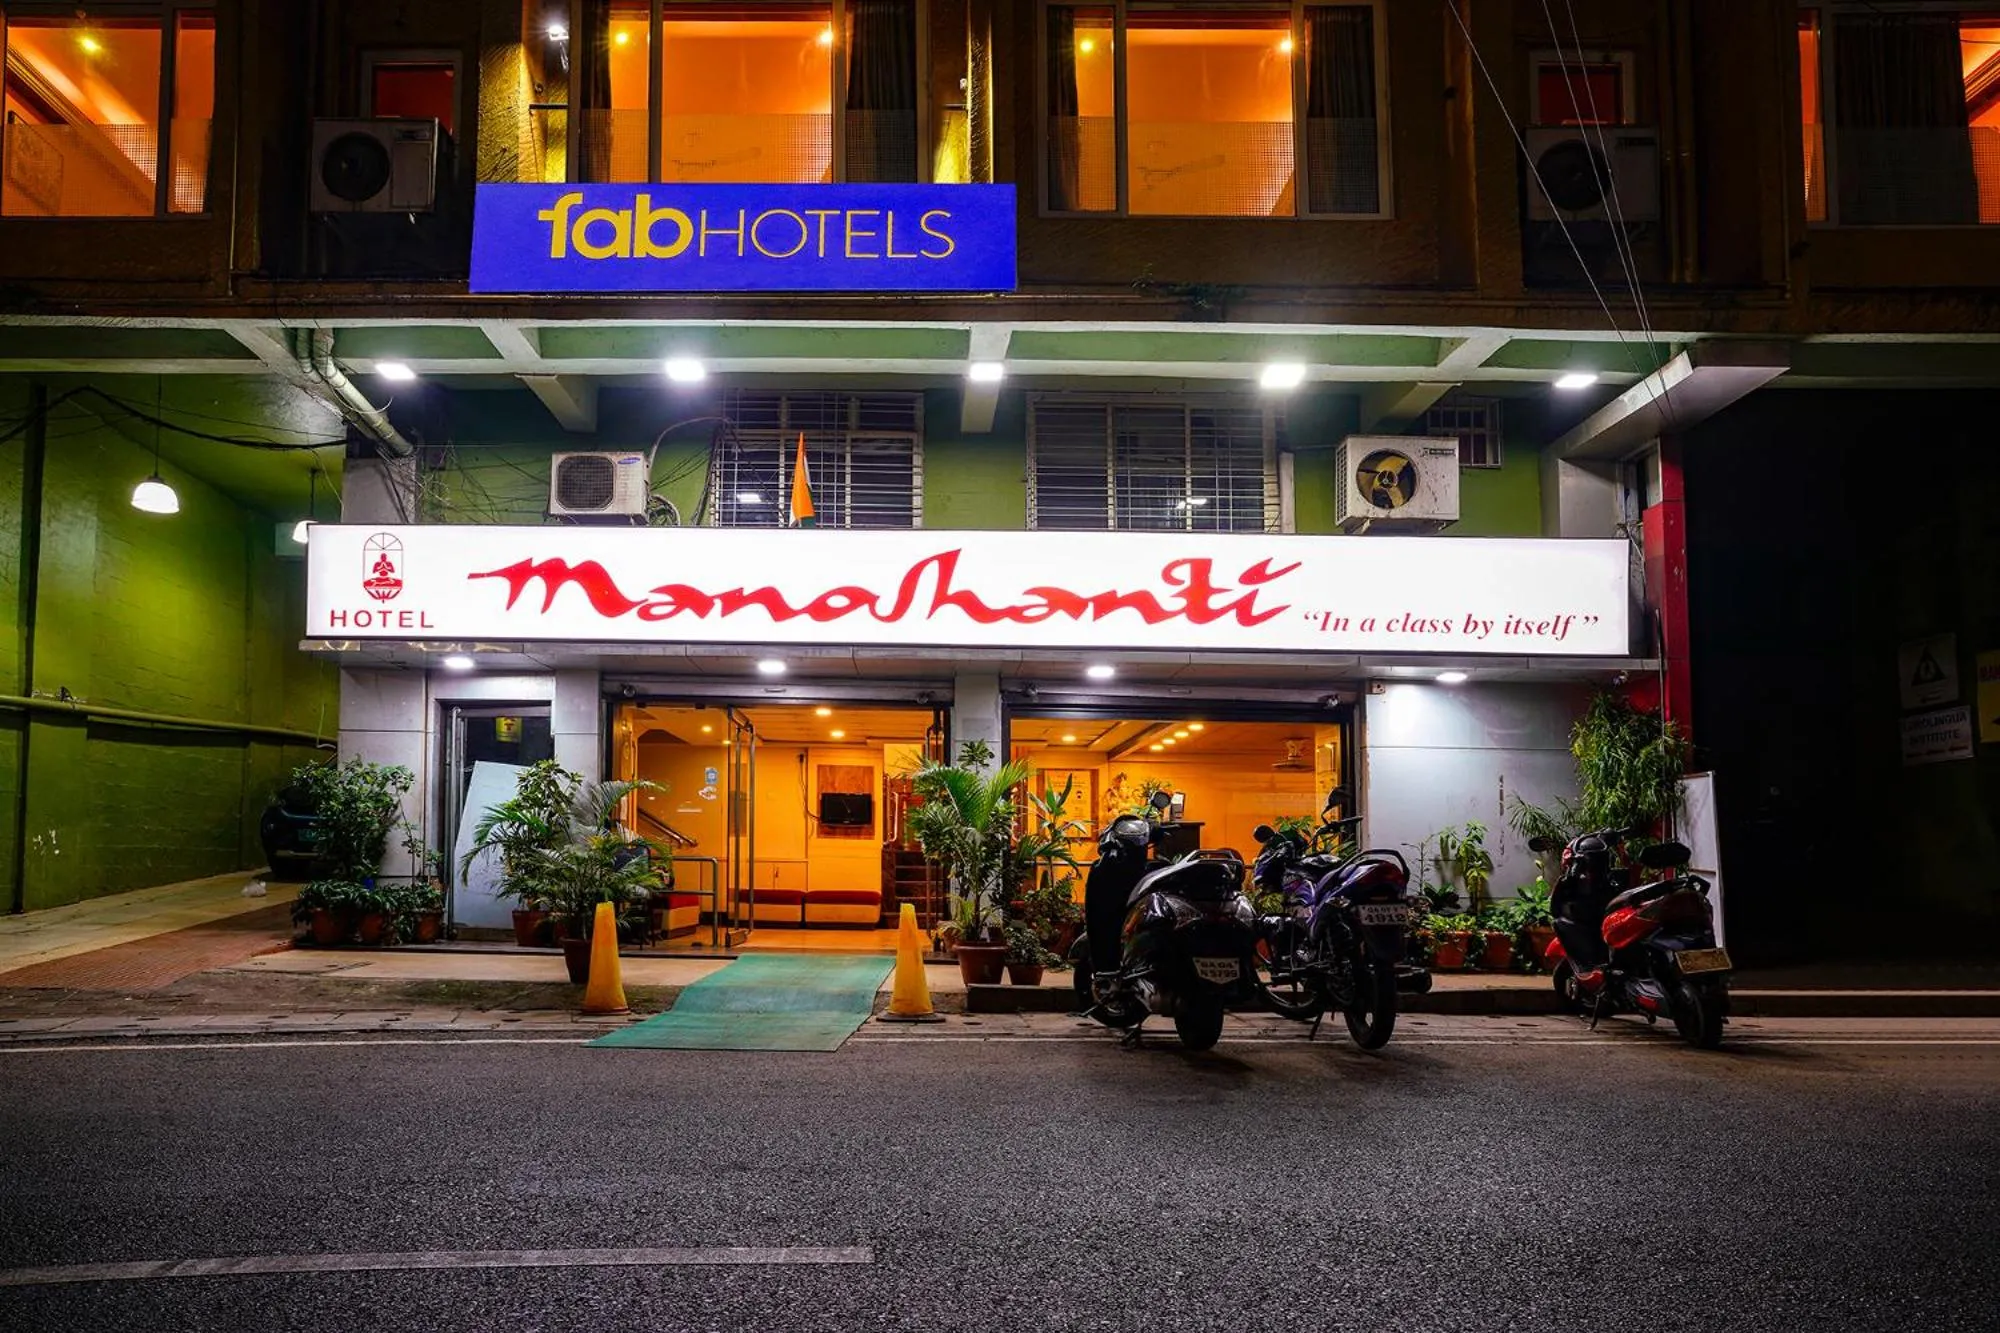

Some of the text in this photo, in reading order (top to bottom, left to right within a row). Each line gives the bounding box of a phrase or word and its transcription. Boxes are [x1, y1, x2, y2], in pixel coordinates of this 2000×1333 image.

[330, 609, 434, 629] HOTEL
[1359, 618, 1375, 633] a
[1386, 612, 1453, 634] class
[1462, 612, 1495, 640] by
